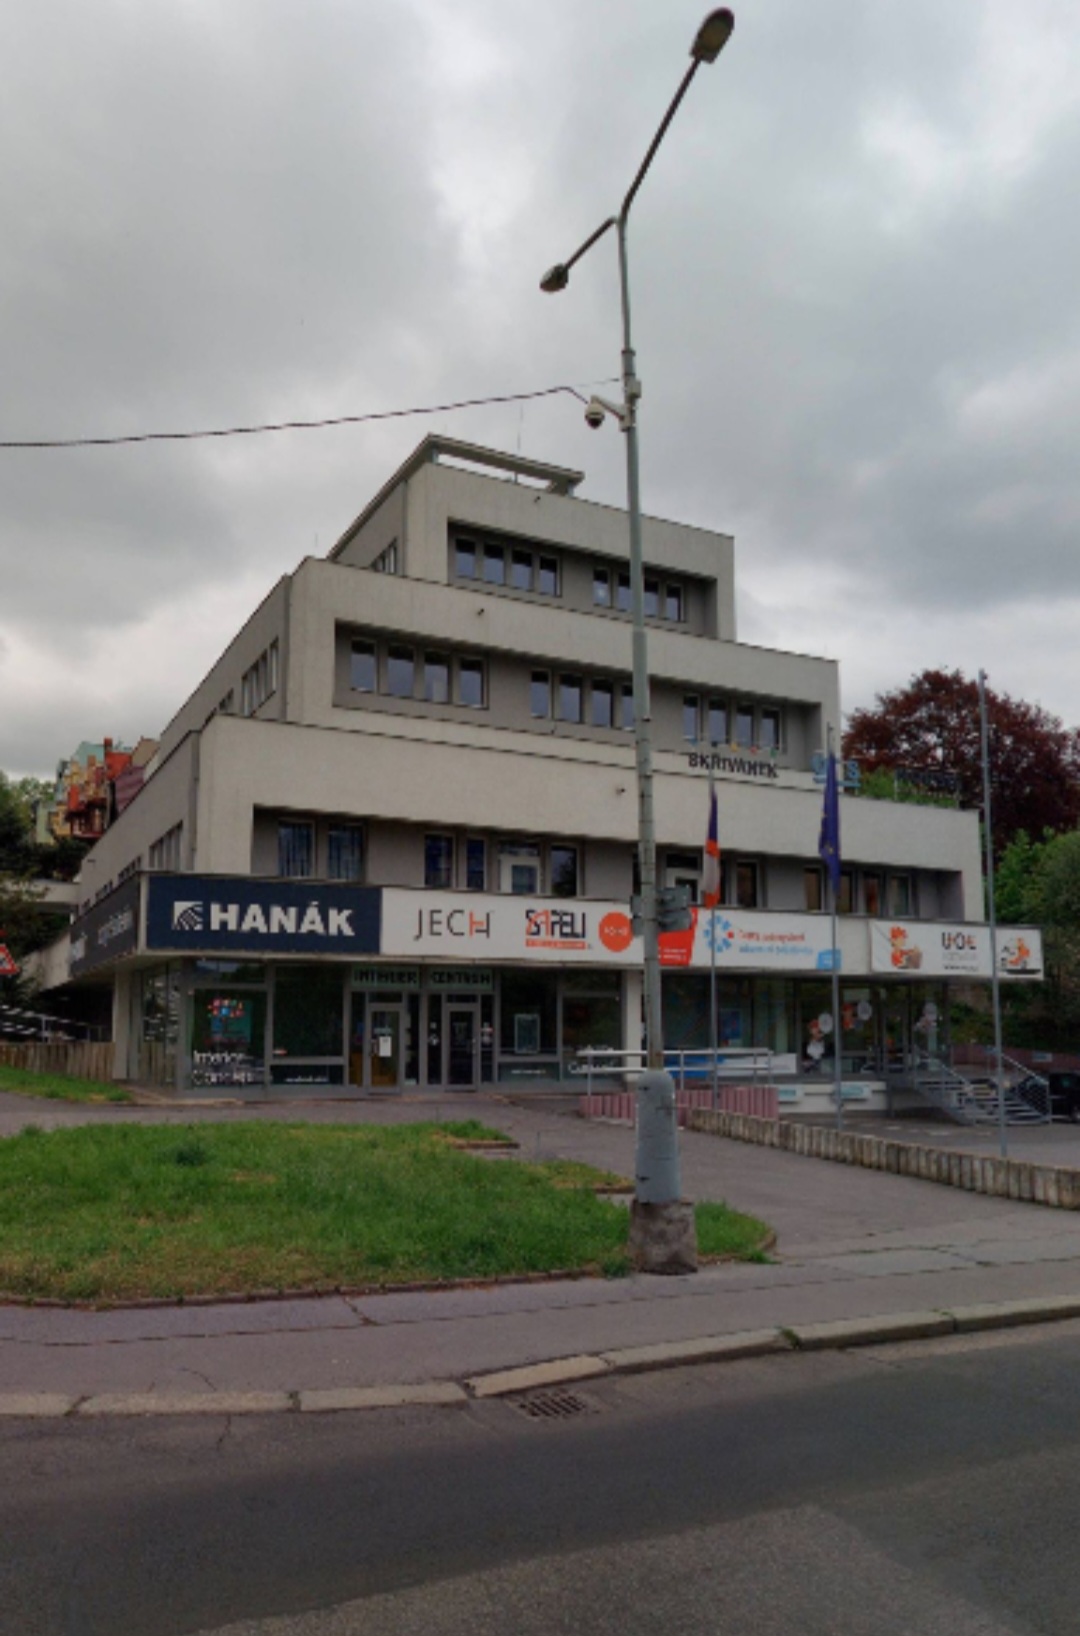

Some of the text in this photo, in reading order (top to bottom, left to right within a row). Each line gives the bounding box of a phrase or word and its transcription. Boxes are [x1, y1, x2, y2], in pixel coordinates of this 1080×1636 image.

[209, 900, 355, 936] HANÁK
[413, 907, 490, 941] JECH
[525, 909, 586, 938] SAPELI
